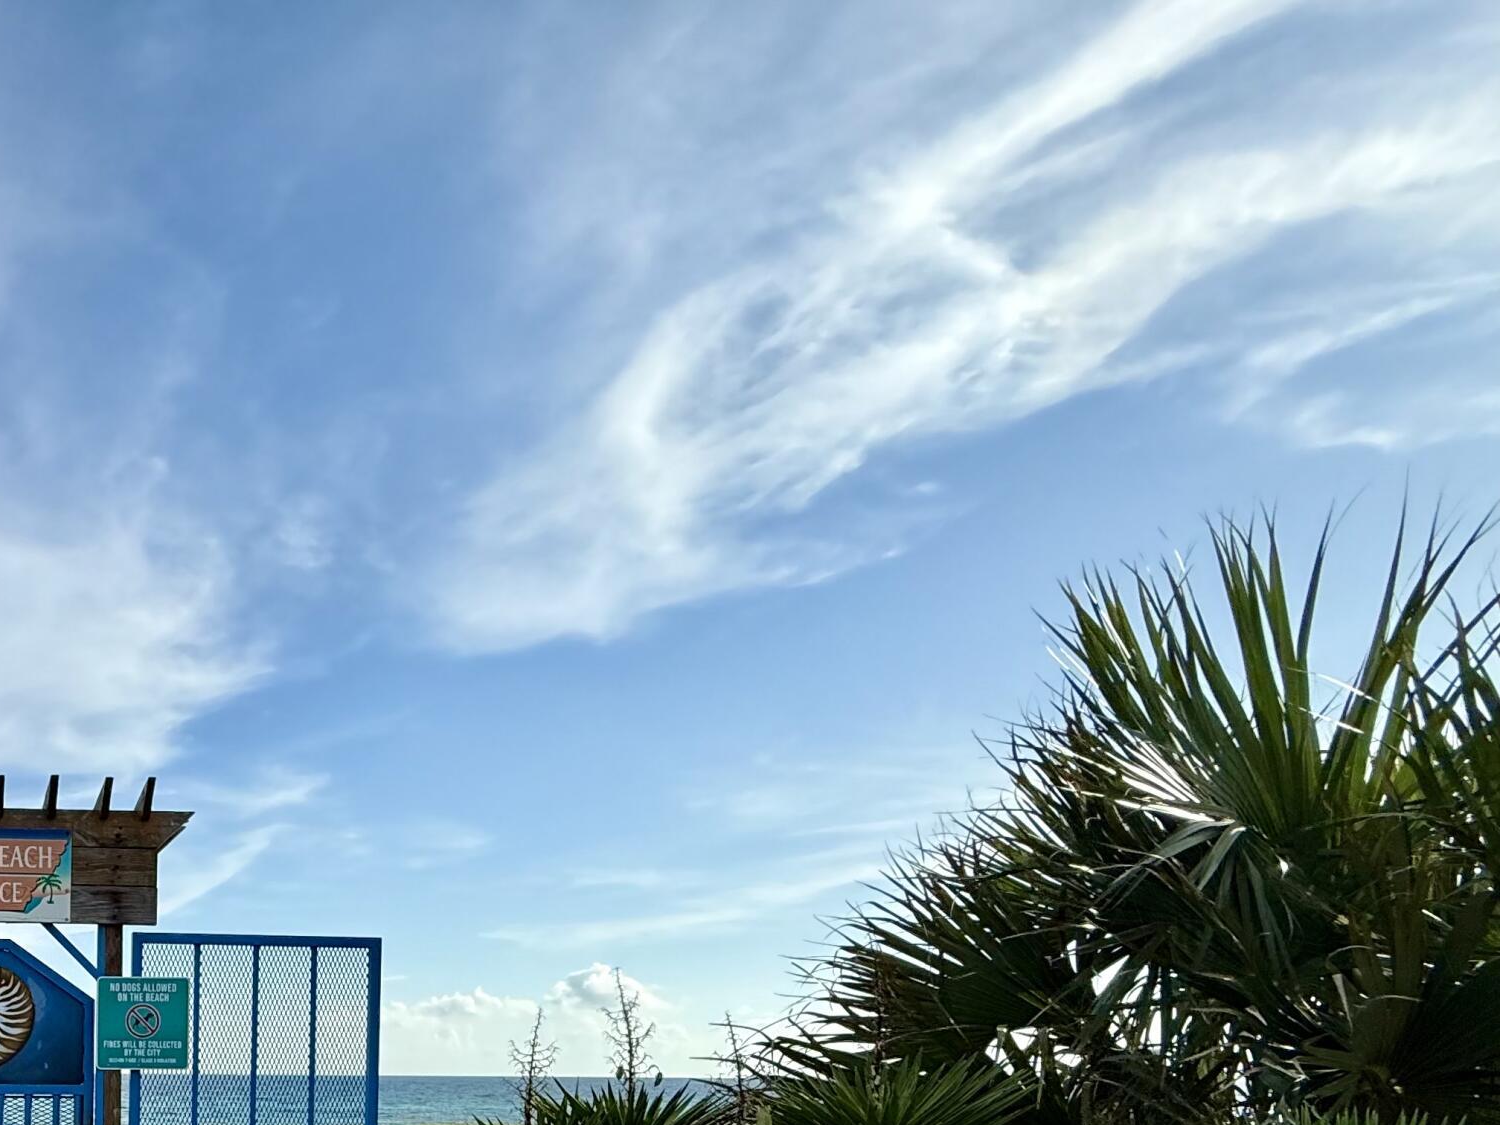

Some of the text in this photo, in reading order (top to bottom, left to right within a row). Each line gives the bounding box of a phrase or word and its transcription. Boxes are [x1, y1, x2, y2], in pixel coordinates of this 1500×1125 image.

[110, 983, 177, 992] NO DOGS ALLOWED
[117, 993, 169, 1002] ON THE BEACH
[104, 1040, 121, 1048] FINES
